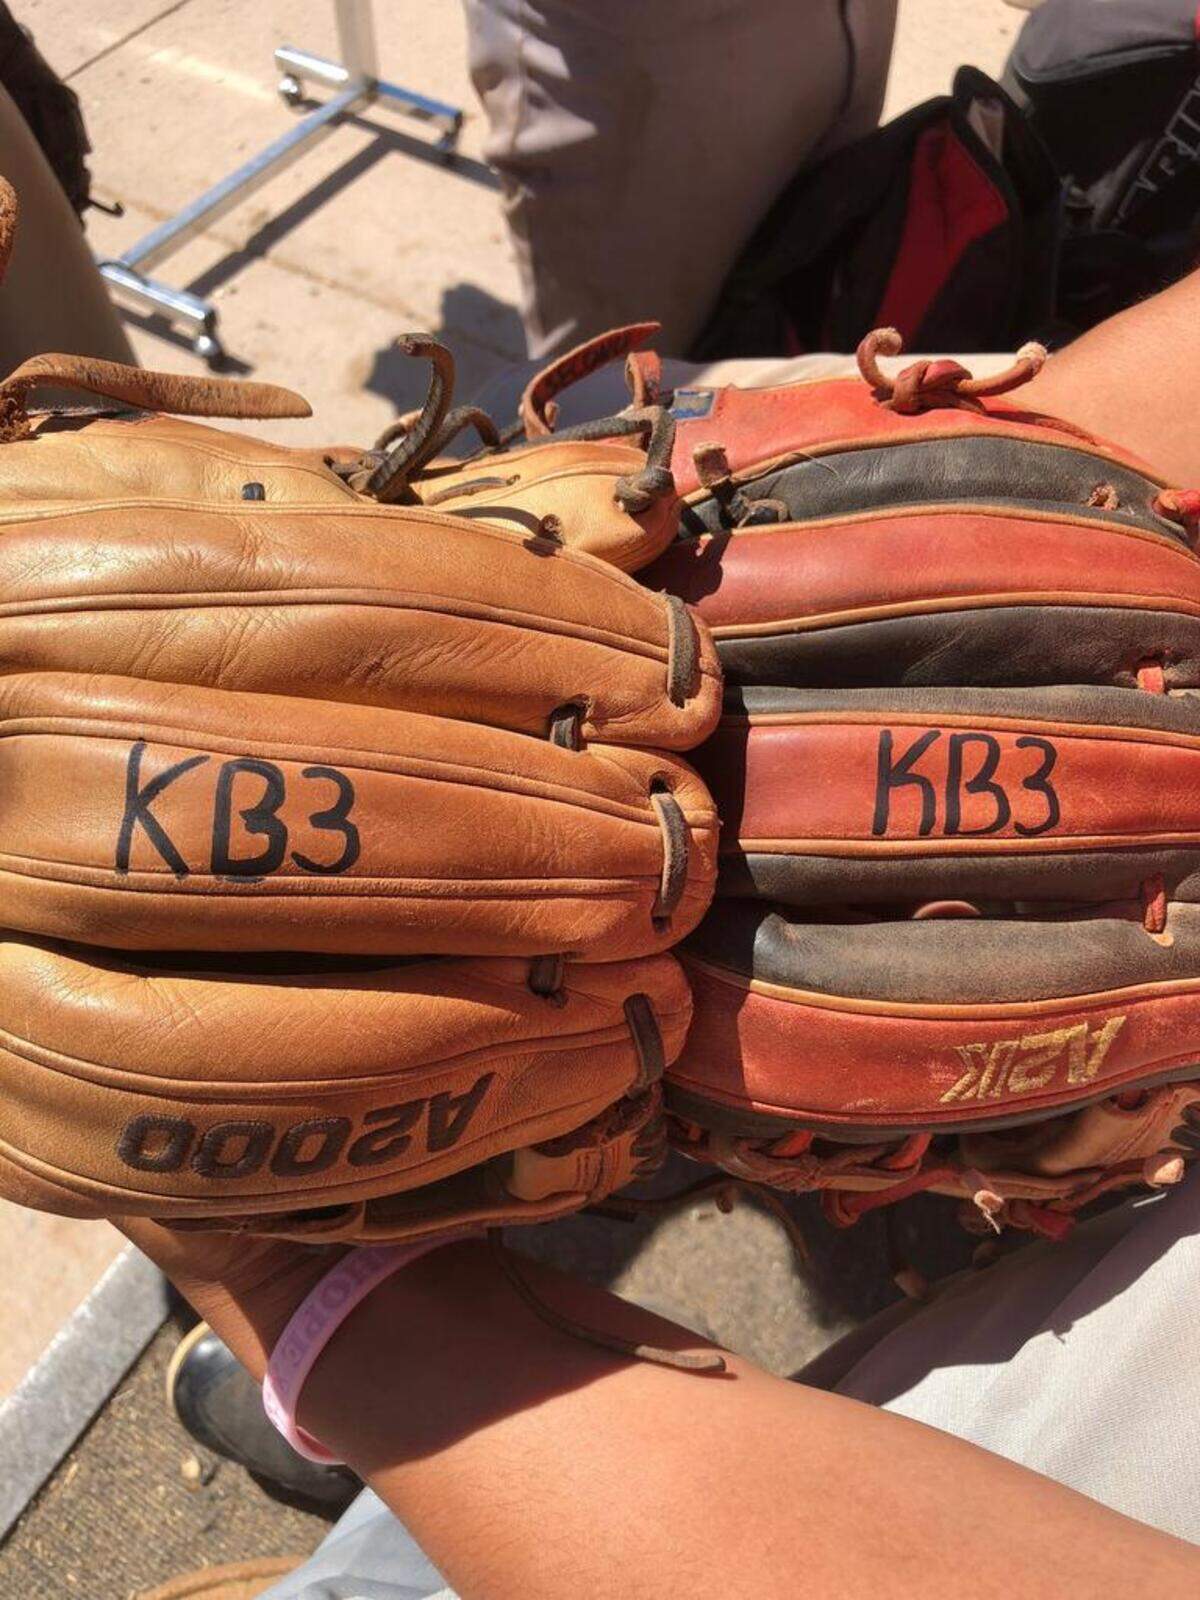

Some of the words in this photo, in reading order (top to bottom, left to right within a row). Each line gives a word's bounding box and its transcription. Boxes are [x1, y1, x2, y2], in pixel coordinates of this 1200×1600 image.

[115, 738, 360, 883] KB3
[872, 729, 1060, 835] KB3
[116, 1071, 496, 1179] A2000
